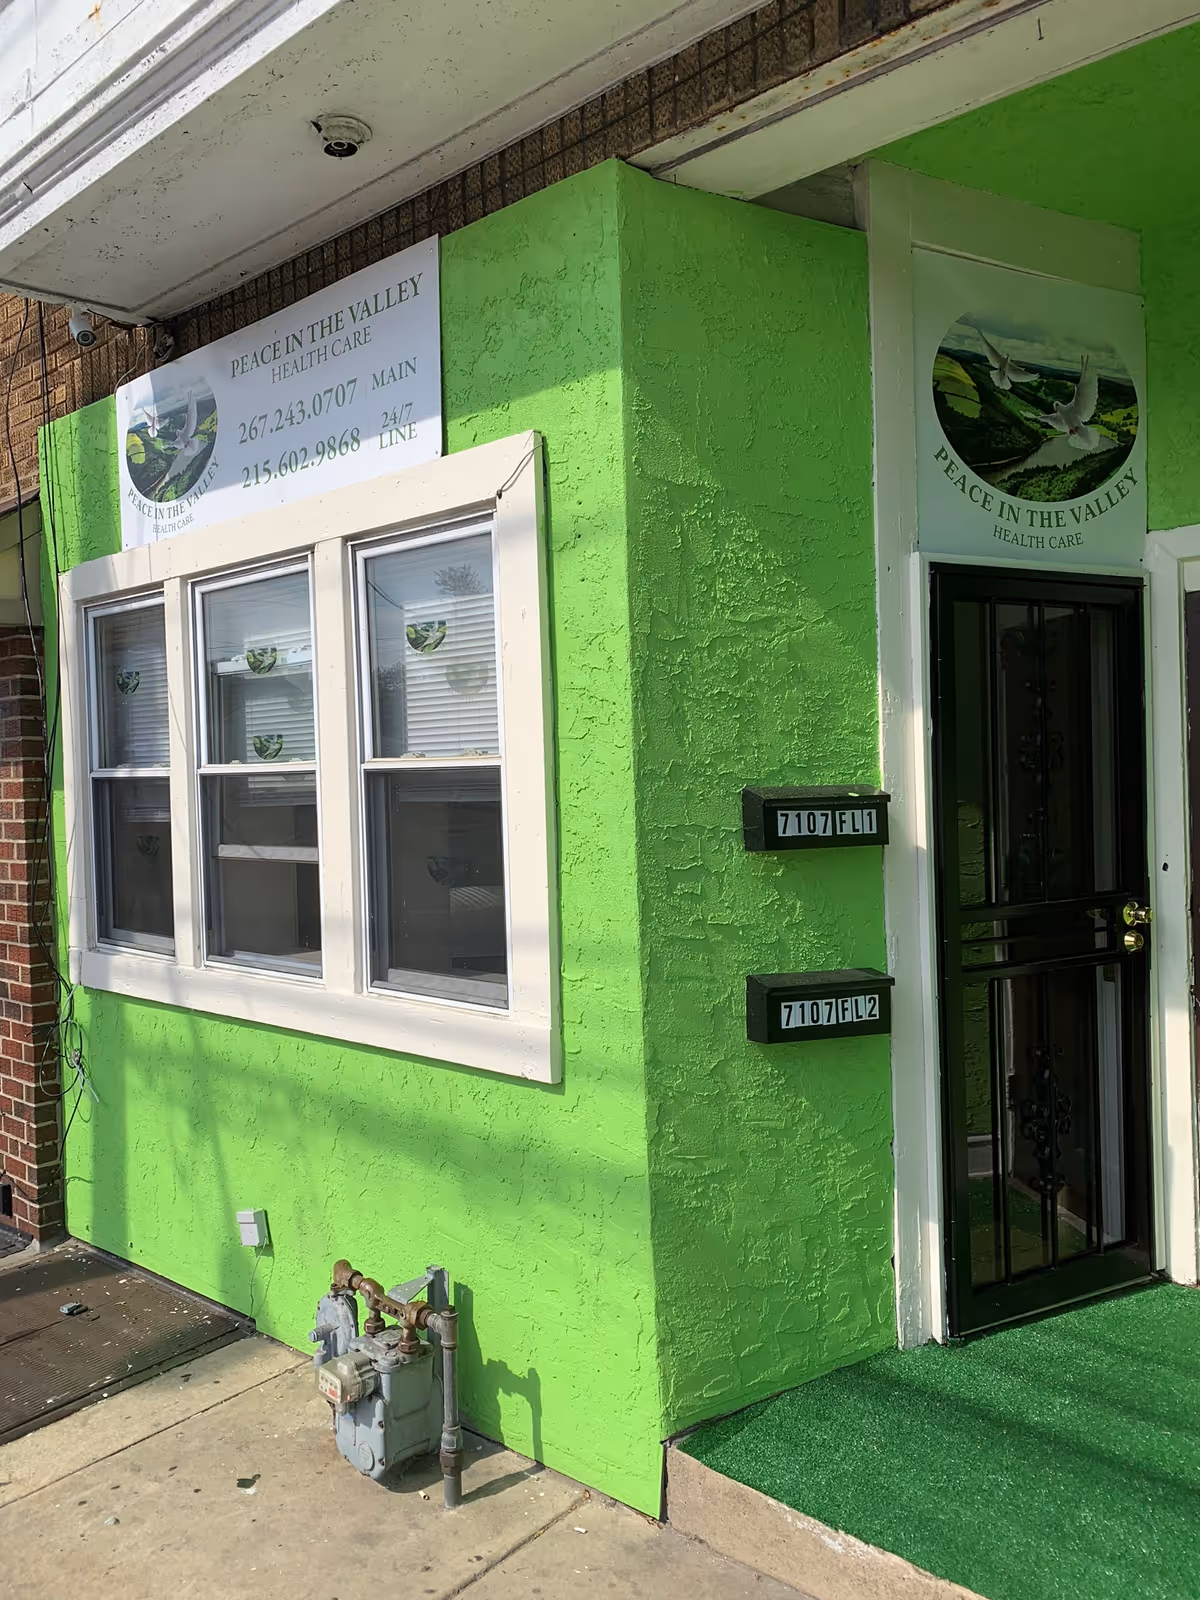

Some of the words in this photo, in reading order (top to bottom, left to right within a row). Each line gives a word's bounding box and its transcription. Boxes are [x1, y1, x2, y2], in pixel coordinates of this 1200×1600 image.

[231, 340, 281, 378] PEACE
[285, 329, 303, 355] IN
[307, 310, 345, 344] THE
[348, 272, 423, 324] VALLEY
[272, 345, 328, 384] HEALTH
[331, 325, 372, 357] CARE
[238, 378, 357, 444] 267.243.0707
[371, 356, 418, 390] MAIN
[381, 402, 413, 428] 24/7
[242, 427, 361, 488] 215.602.9868
[379, 422, 418, 449] LINE
[127, 488, 153, 518] PEACE
[155, 507, 164, 520] IN
[167, 501, 185, 519] THE
[186, 456, 219, 507] VALLEY
[933, 445, 995, 512] PEACE
[998, 501, 1021, 524] IN
[1027, 509, 1067, 528] THE
[1069, 467, 1139, 524] VALLEY
[152, 523, 176, 533] HEALTH
[177, 513, 194, 529] CARE
[993, 525, 1045, 548] HEALTH
[1049, 532, 1084, 549] CARE
